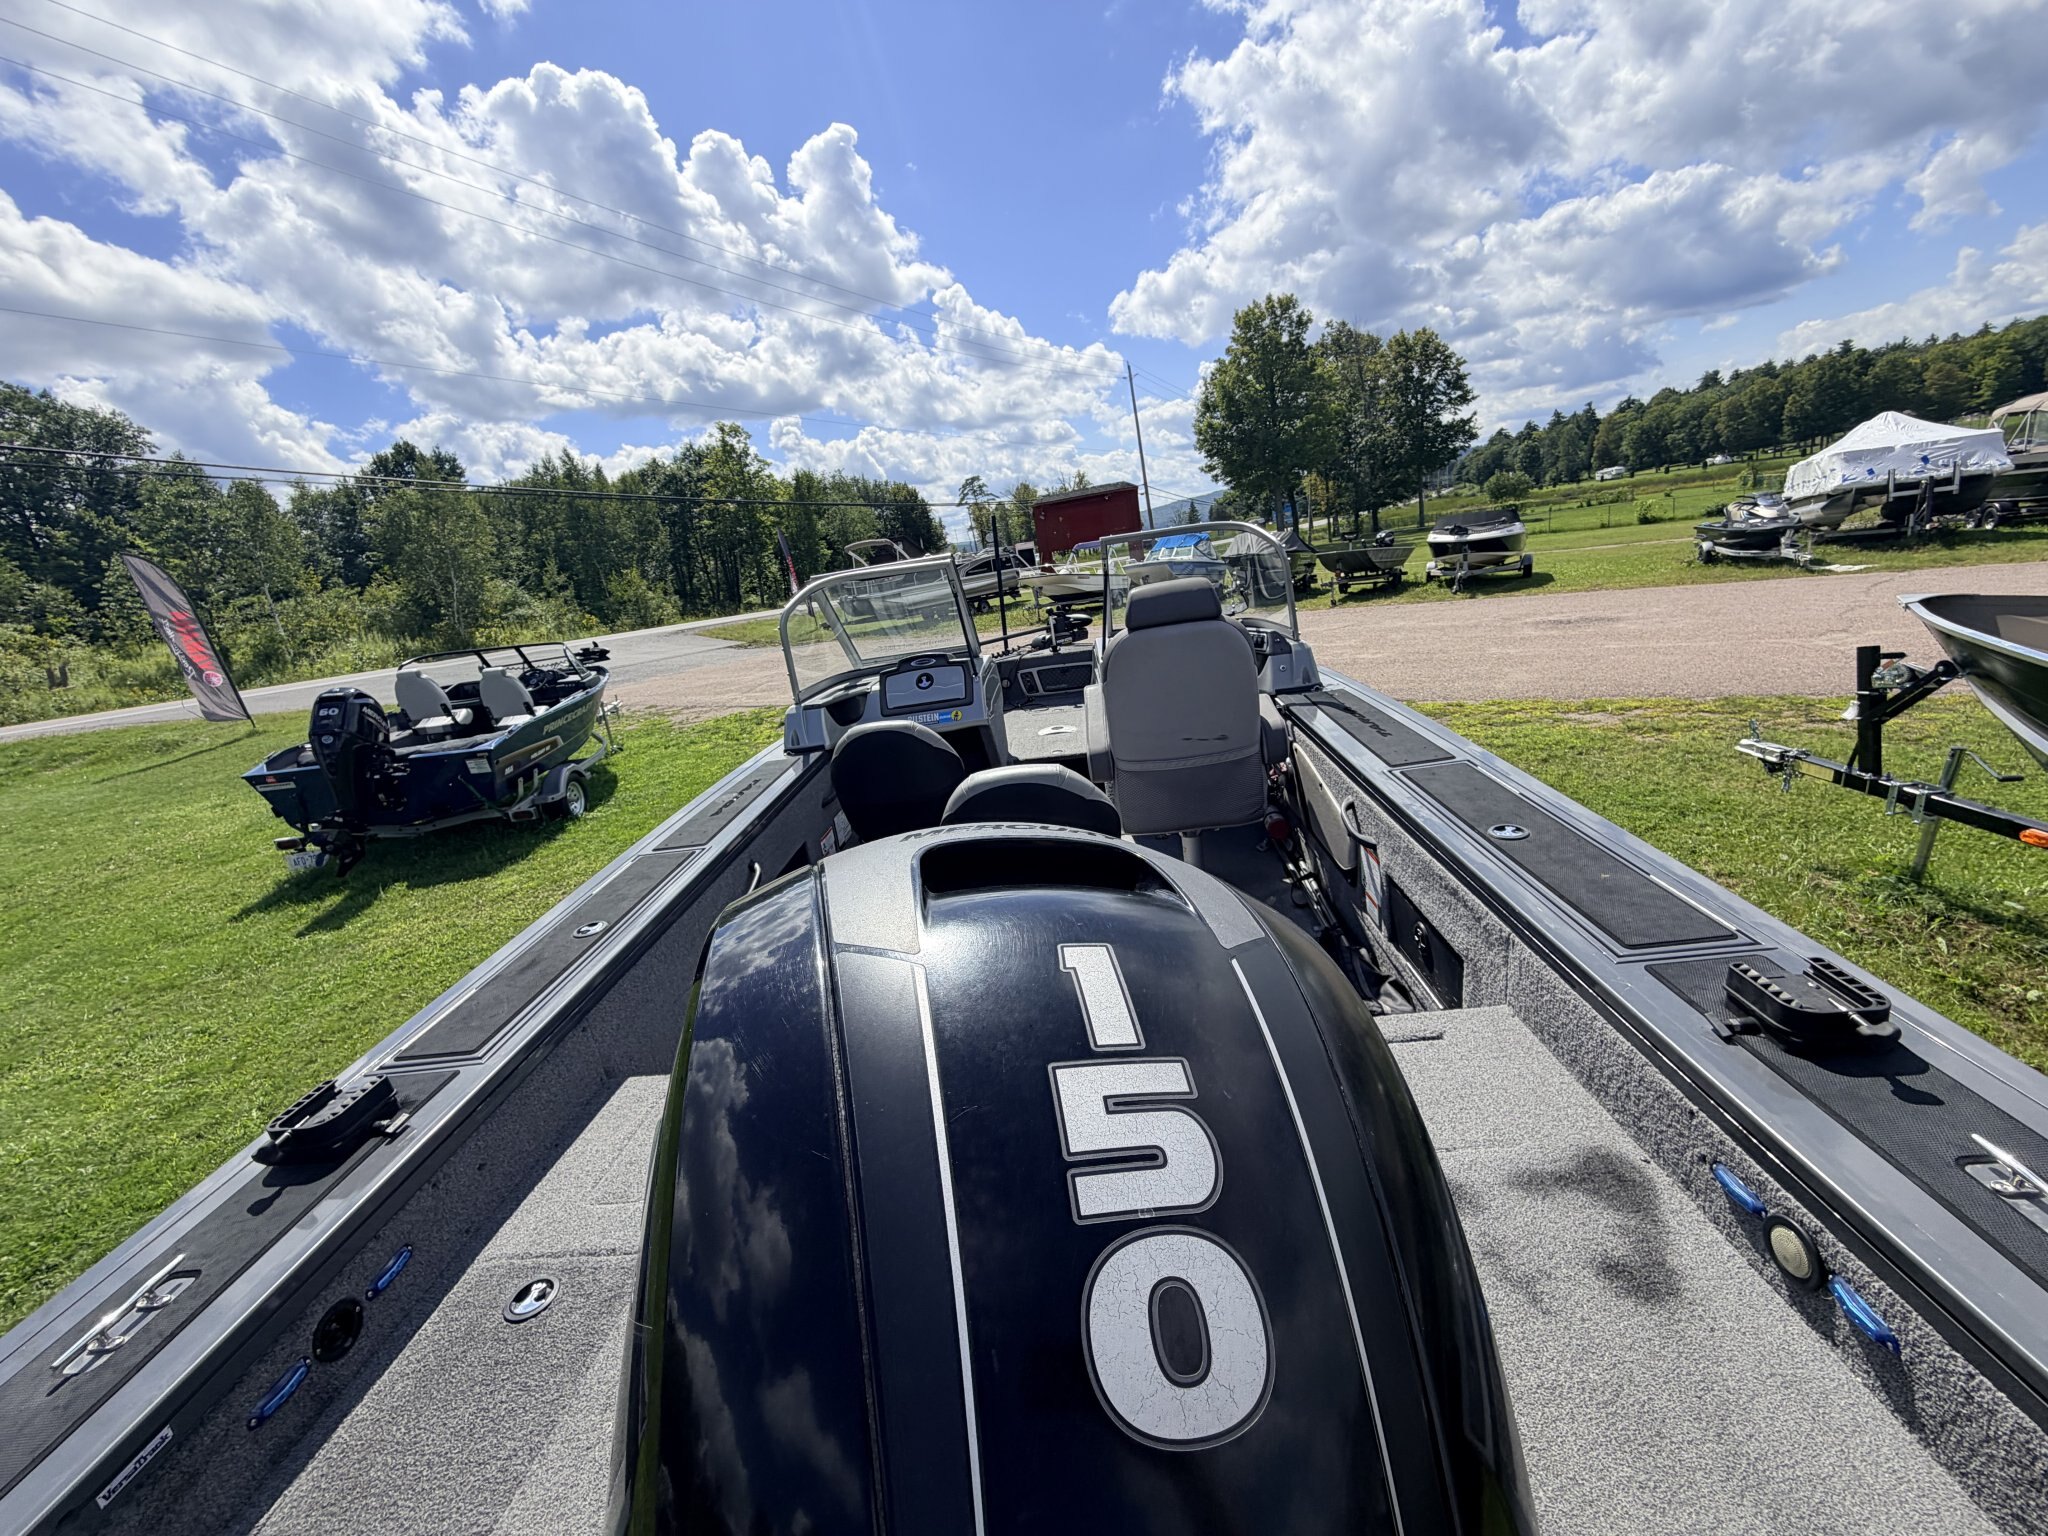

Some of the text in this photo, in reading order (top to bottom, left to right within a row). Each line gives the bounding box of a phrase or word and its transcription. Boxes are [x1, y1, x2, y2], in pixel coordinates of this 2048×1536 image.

[319, 707, 339, 717] 60
[1048, 942, 1276, 1452] 150
[101, 1432, 169, 1501] VersaTrack
